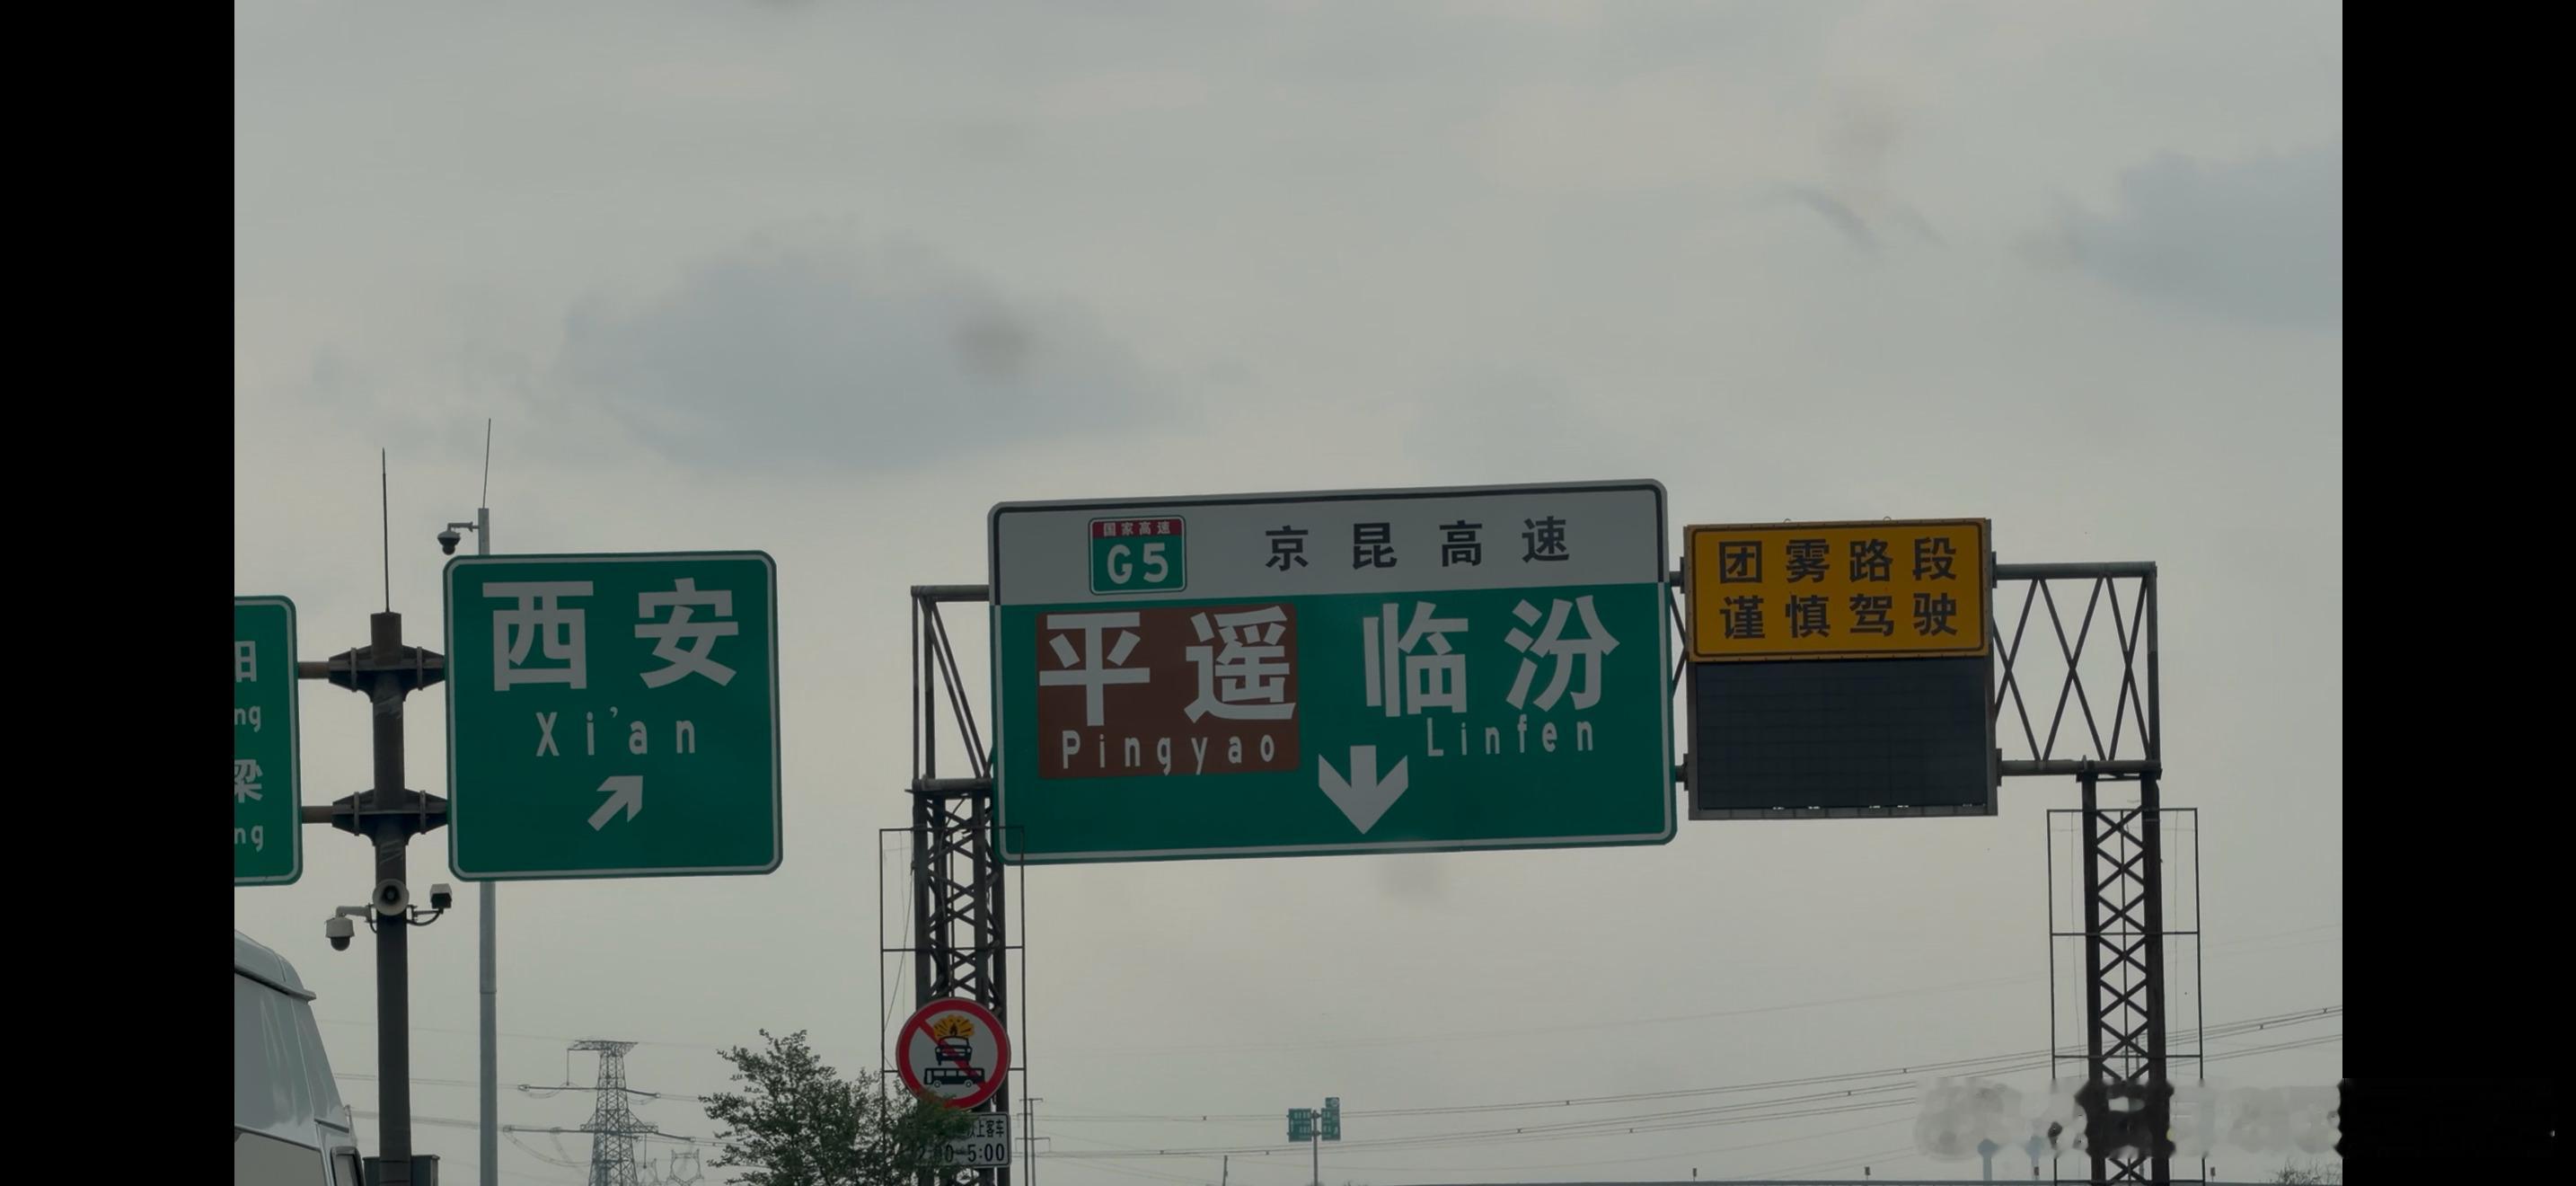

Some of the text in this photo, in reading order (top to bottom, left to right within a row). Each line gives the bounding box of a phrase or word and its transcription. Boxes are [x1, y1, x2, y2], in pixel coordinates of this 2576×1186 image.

[1102, 520, 1170, 537] 国家高速
[1266, 516, 1570, 571] 京昆高速
[1107, 542, 1169, 585] G5
[1719, 537, 1956, 584] 团雾路段
[482, 578, 739, 691] 西安
[1719, 593, 1957, 639] 谨慎驾驶
[1039, 606, 1296, 726] 平遥
[1363, 595, 1620, 718] 临汾
[1062, 730, 1275, 775] Pingyao
[1426, 715, 1593, 757] Linfen
